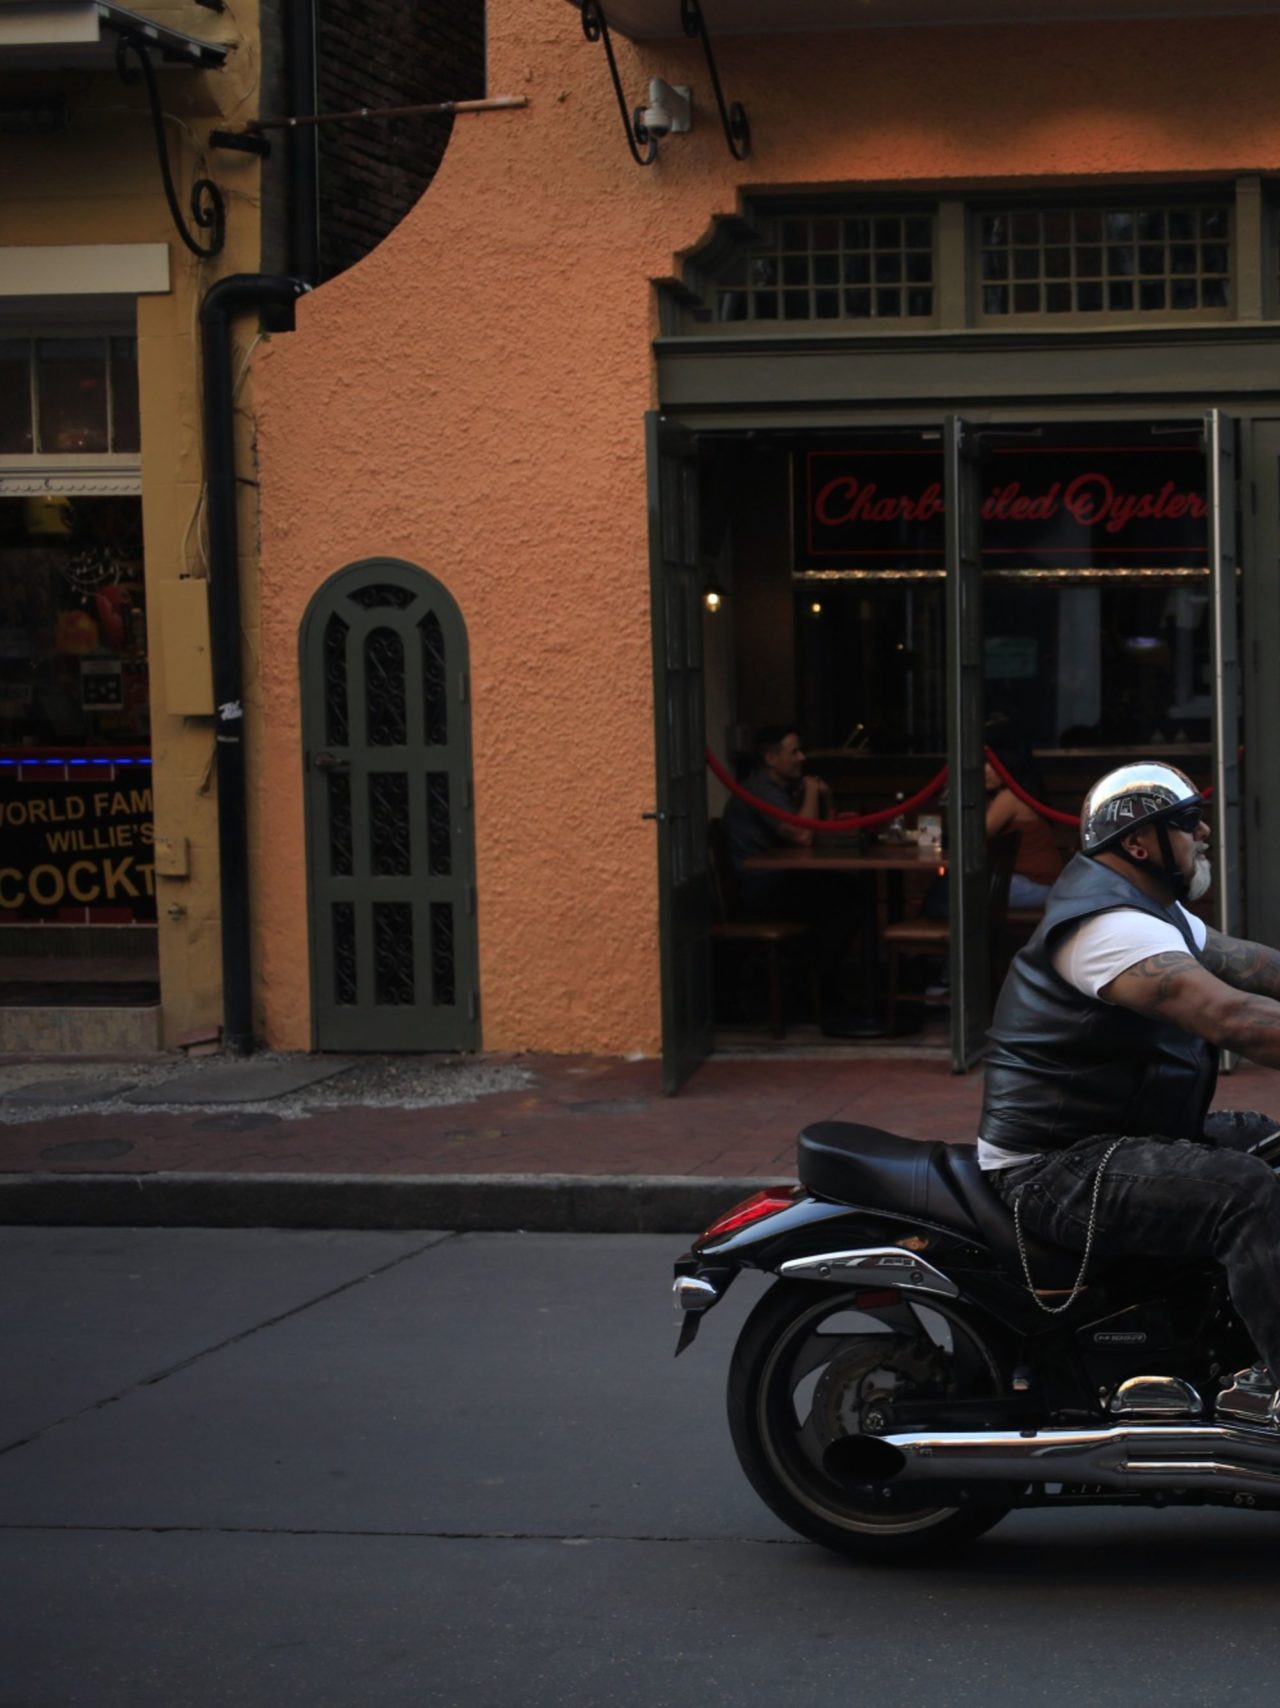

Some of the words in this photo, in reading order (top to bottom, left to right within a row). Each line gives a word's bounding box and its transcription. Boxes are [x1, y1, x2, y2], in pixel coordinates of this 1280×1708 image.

[814, 474, 1061, 525] Charbiled
[1062, 471, 1209, 534] Oyster
[46, 822, 155, 855] WILLIE'S
